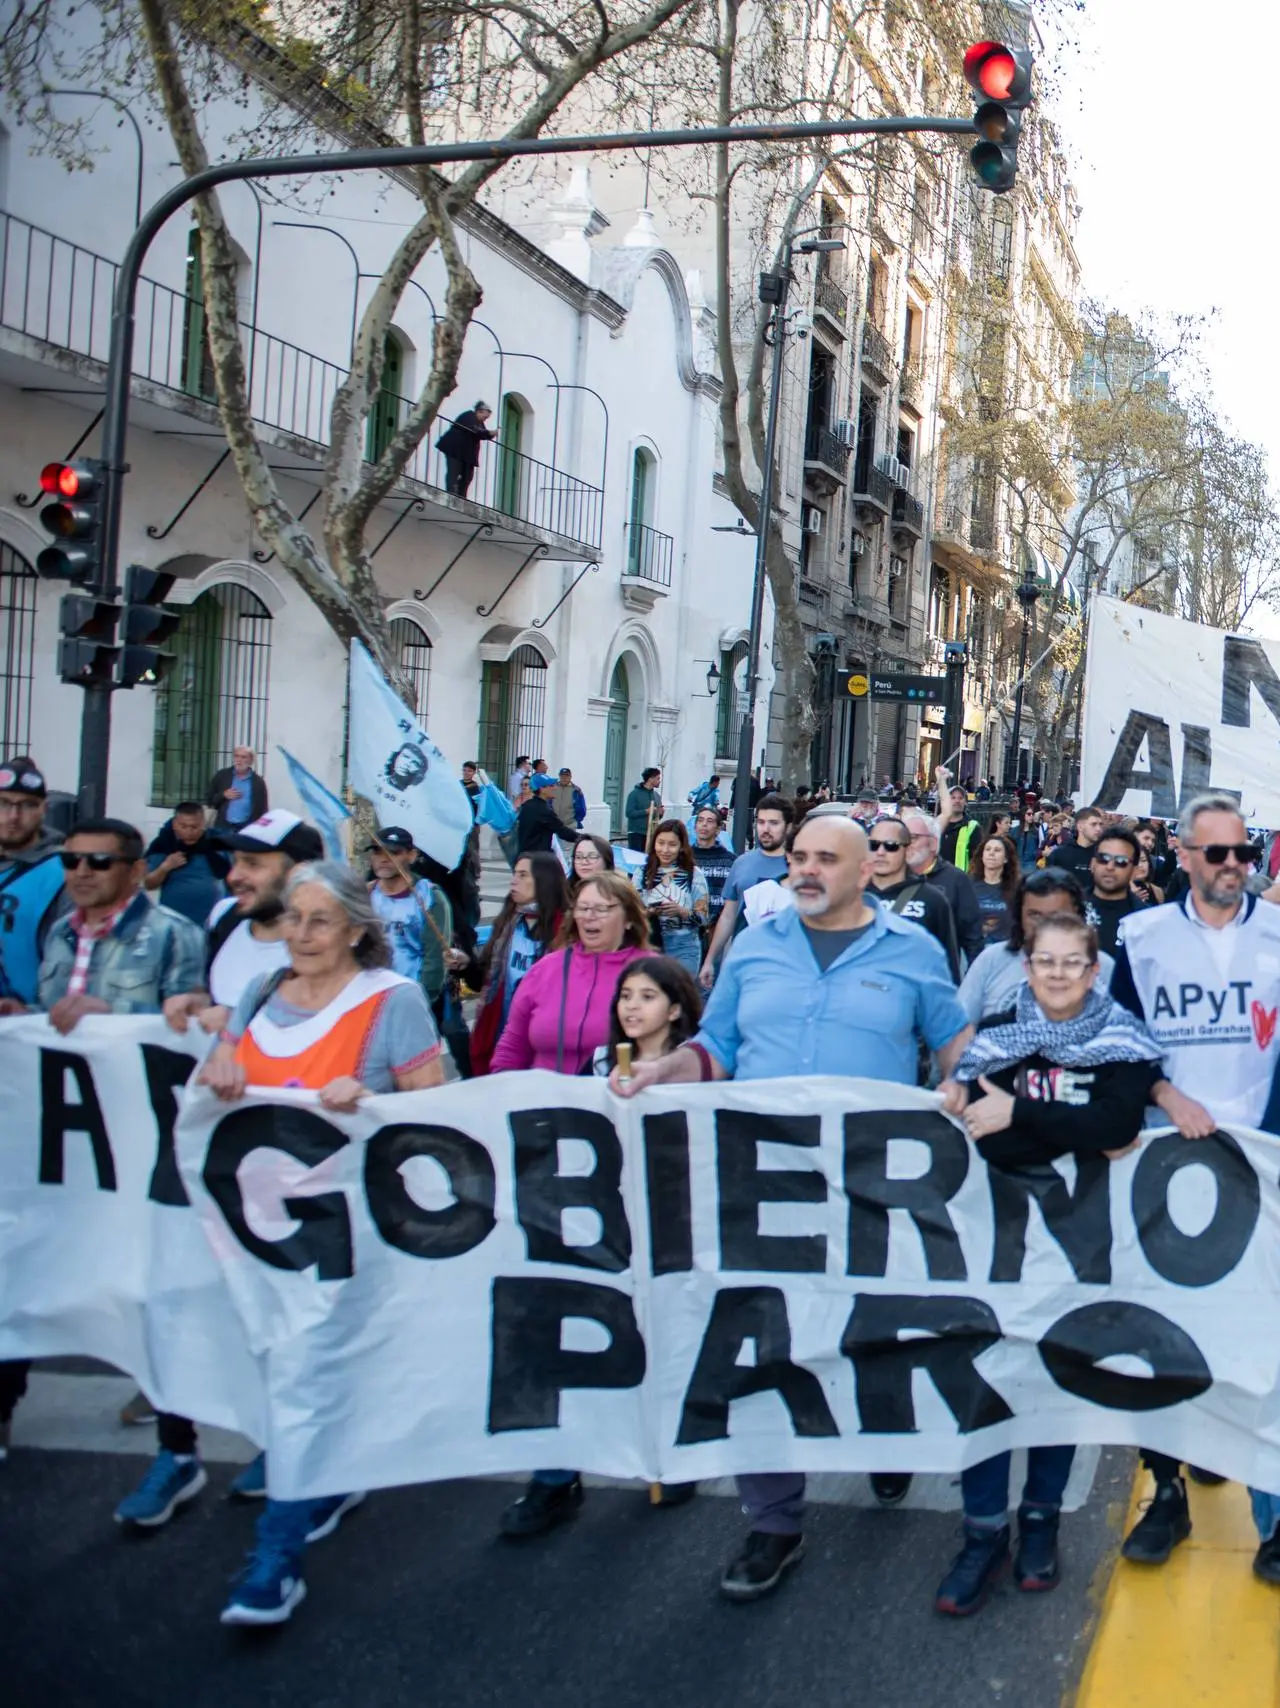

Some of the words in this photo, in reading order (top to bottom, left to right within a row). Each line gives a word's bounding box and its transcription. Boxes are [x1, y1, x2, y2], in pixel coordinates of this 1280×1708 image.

[875, 680, 892, 689] Perú
[1091, 709, 1242, 824] AL
[1153, 981, 1253, 1024] APyT
[1155, 1026, 1195, 1038] Hospital
[1198, 1025, 1251, 1035] Garrahan
[487, 1277, 1213, 1446] PARO
